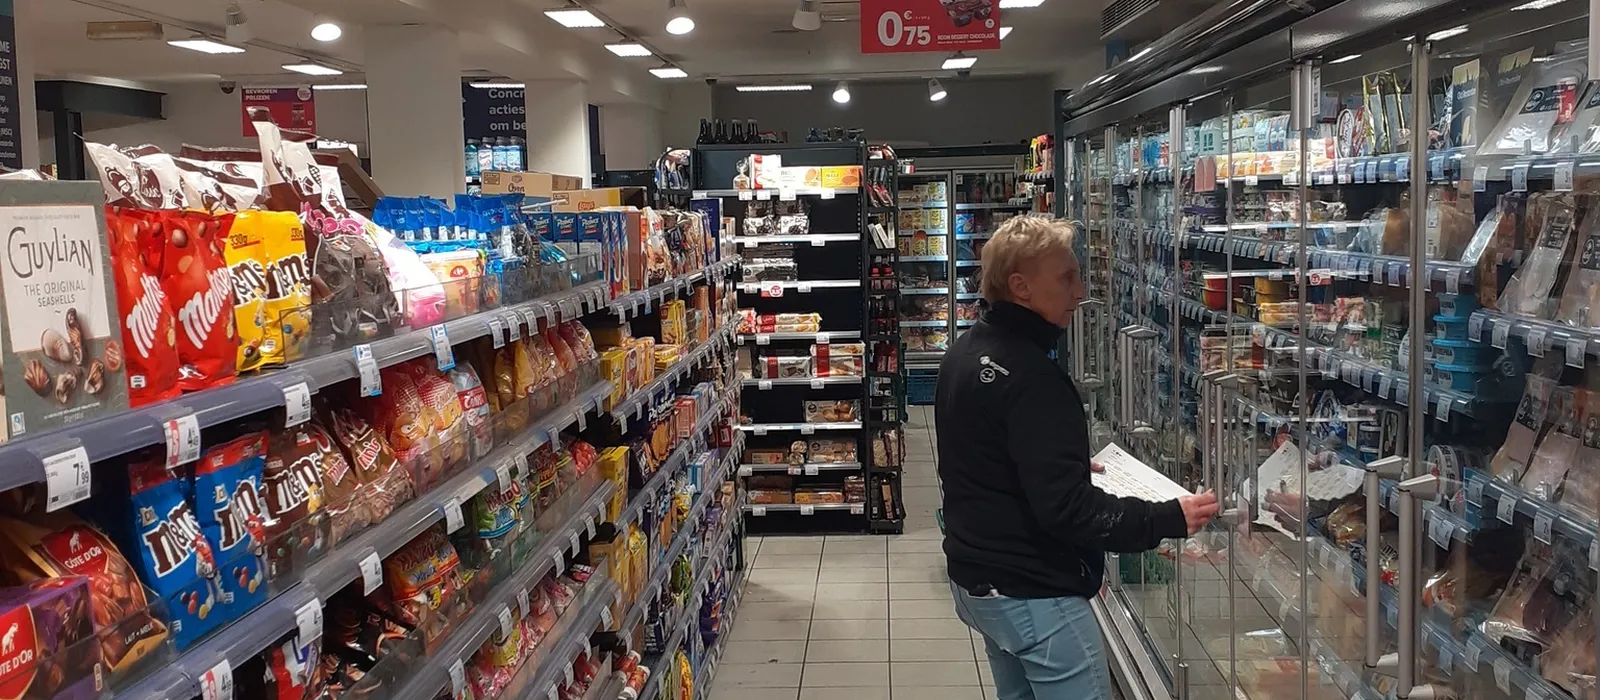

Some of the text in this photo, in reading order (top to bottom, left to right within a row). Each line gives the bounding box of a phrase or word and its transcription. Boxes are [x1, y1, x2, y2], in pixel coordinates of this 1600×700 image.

[877, 11, 903, 47] 0
[904, 26, 931, 46] 75
[489, 103, 525, 115] acties
[490, 122, 510, 131] om
[24, 279, 86, 297] THE ORIGINAL
[37, 293, 76, 308] SEASHELLS
[84, 545, 103, 560] D'OR
[13, 648, 34, 671] D'OR
